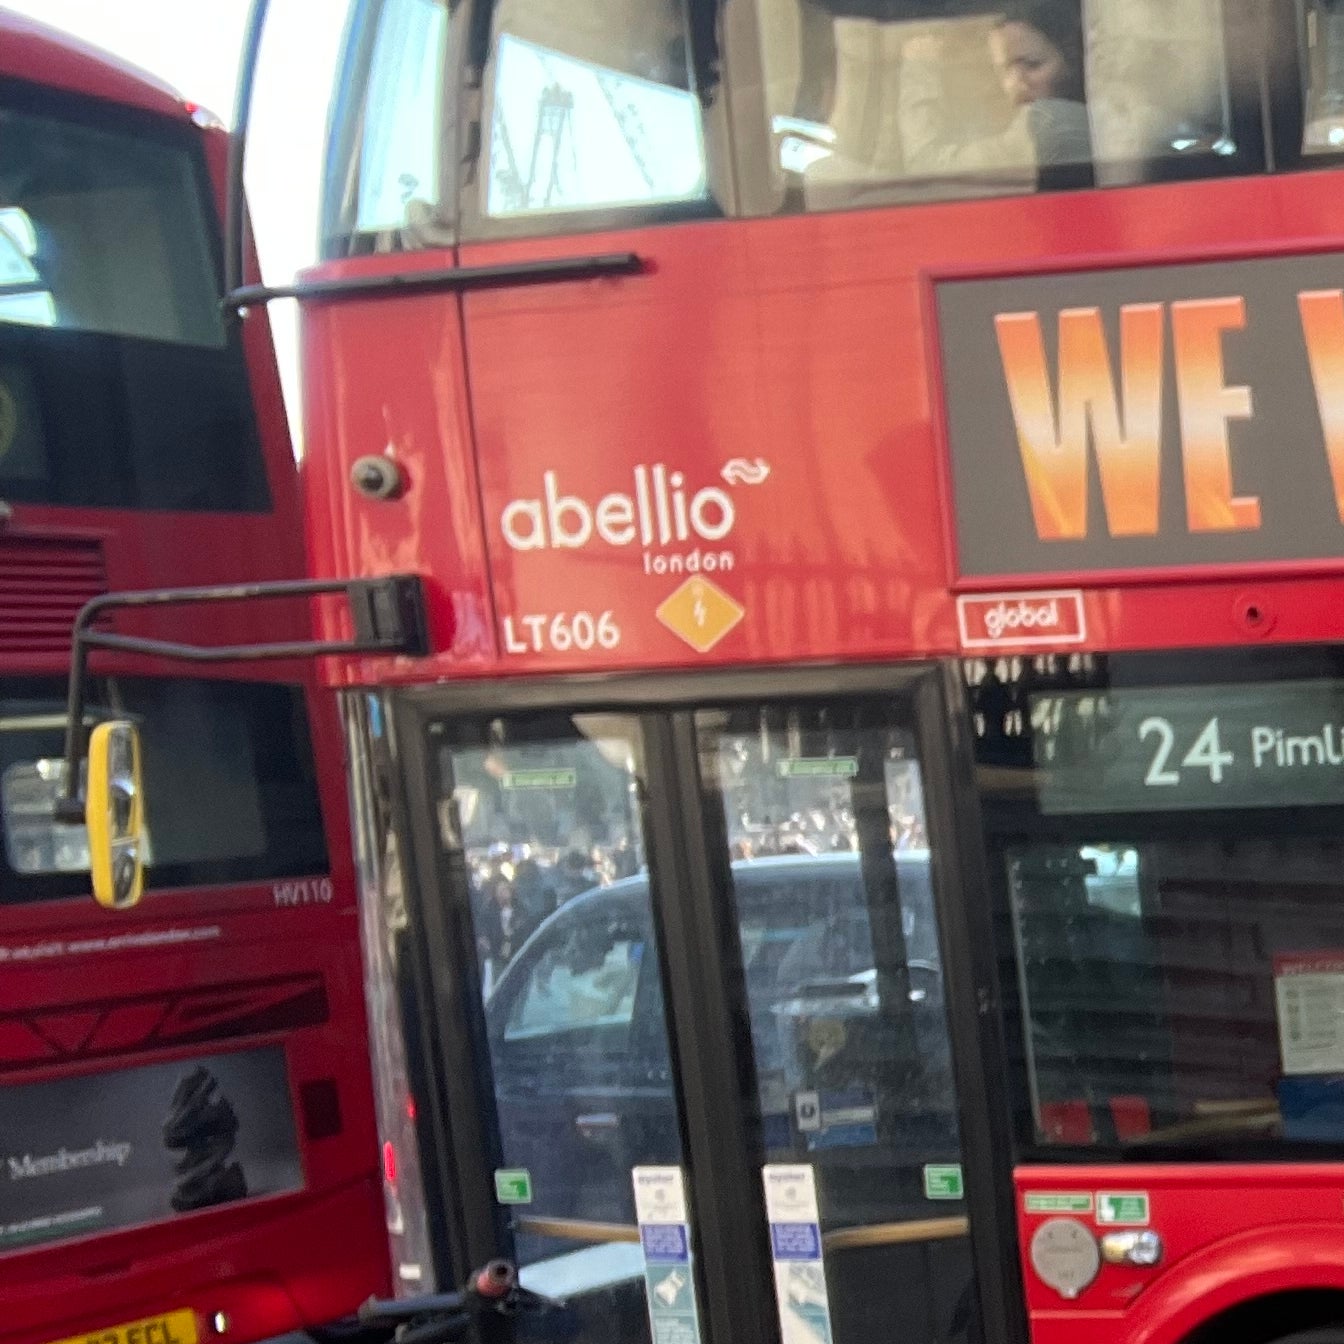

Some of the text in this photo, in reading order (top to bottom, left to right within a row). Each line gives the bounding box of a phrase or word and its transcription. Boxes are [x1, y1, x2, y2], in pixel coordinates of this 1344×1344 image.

[994, 296, 1261, 541] WE
[501, 463, 735, 551] abellio
[642, 549, 735, 574] london
[503, 610, 621, 654] LT606
[984, 599, 1059, 639] global
[1138, 715, 1233, 786] 24
